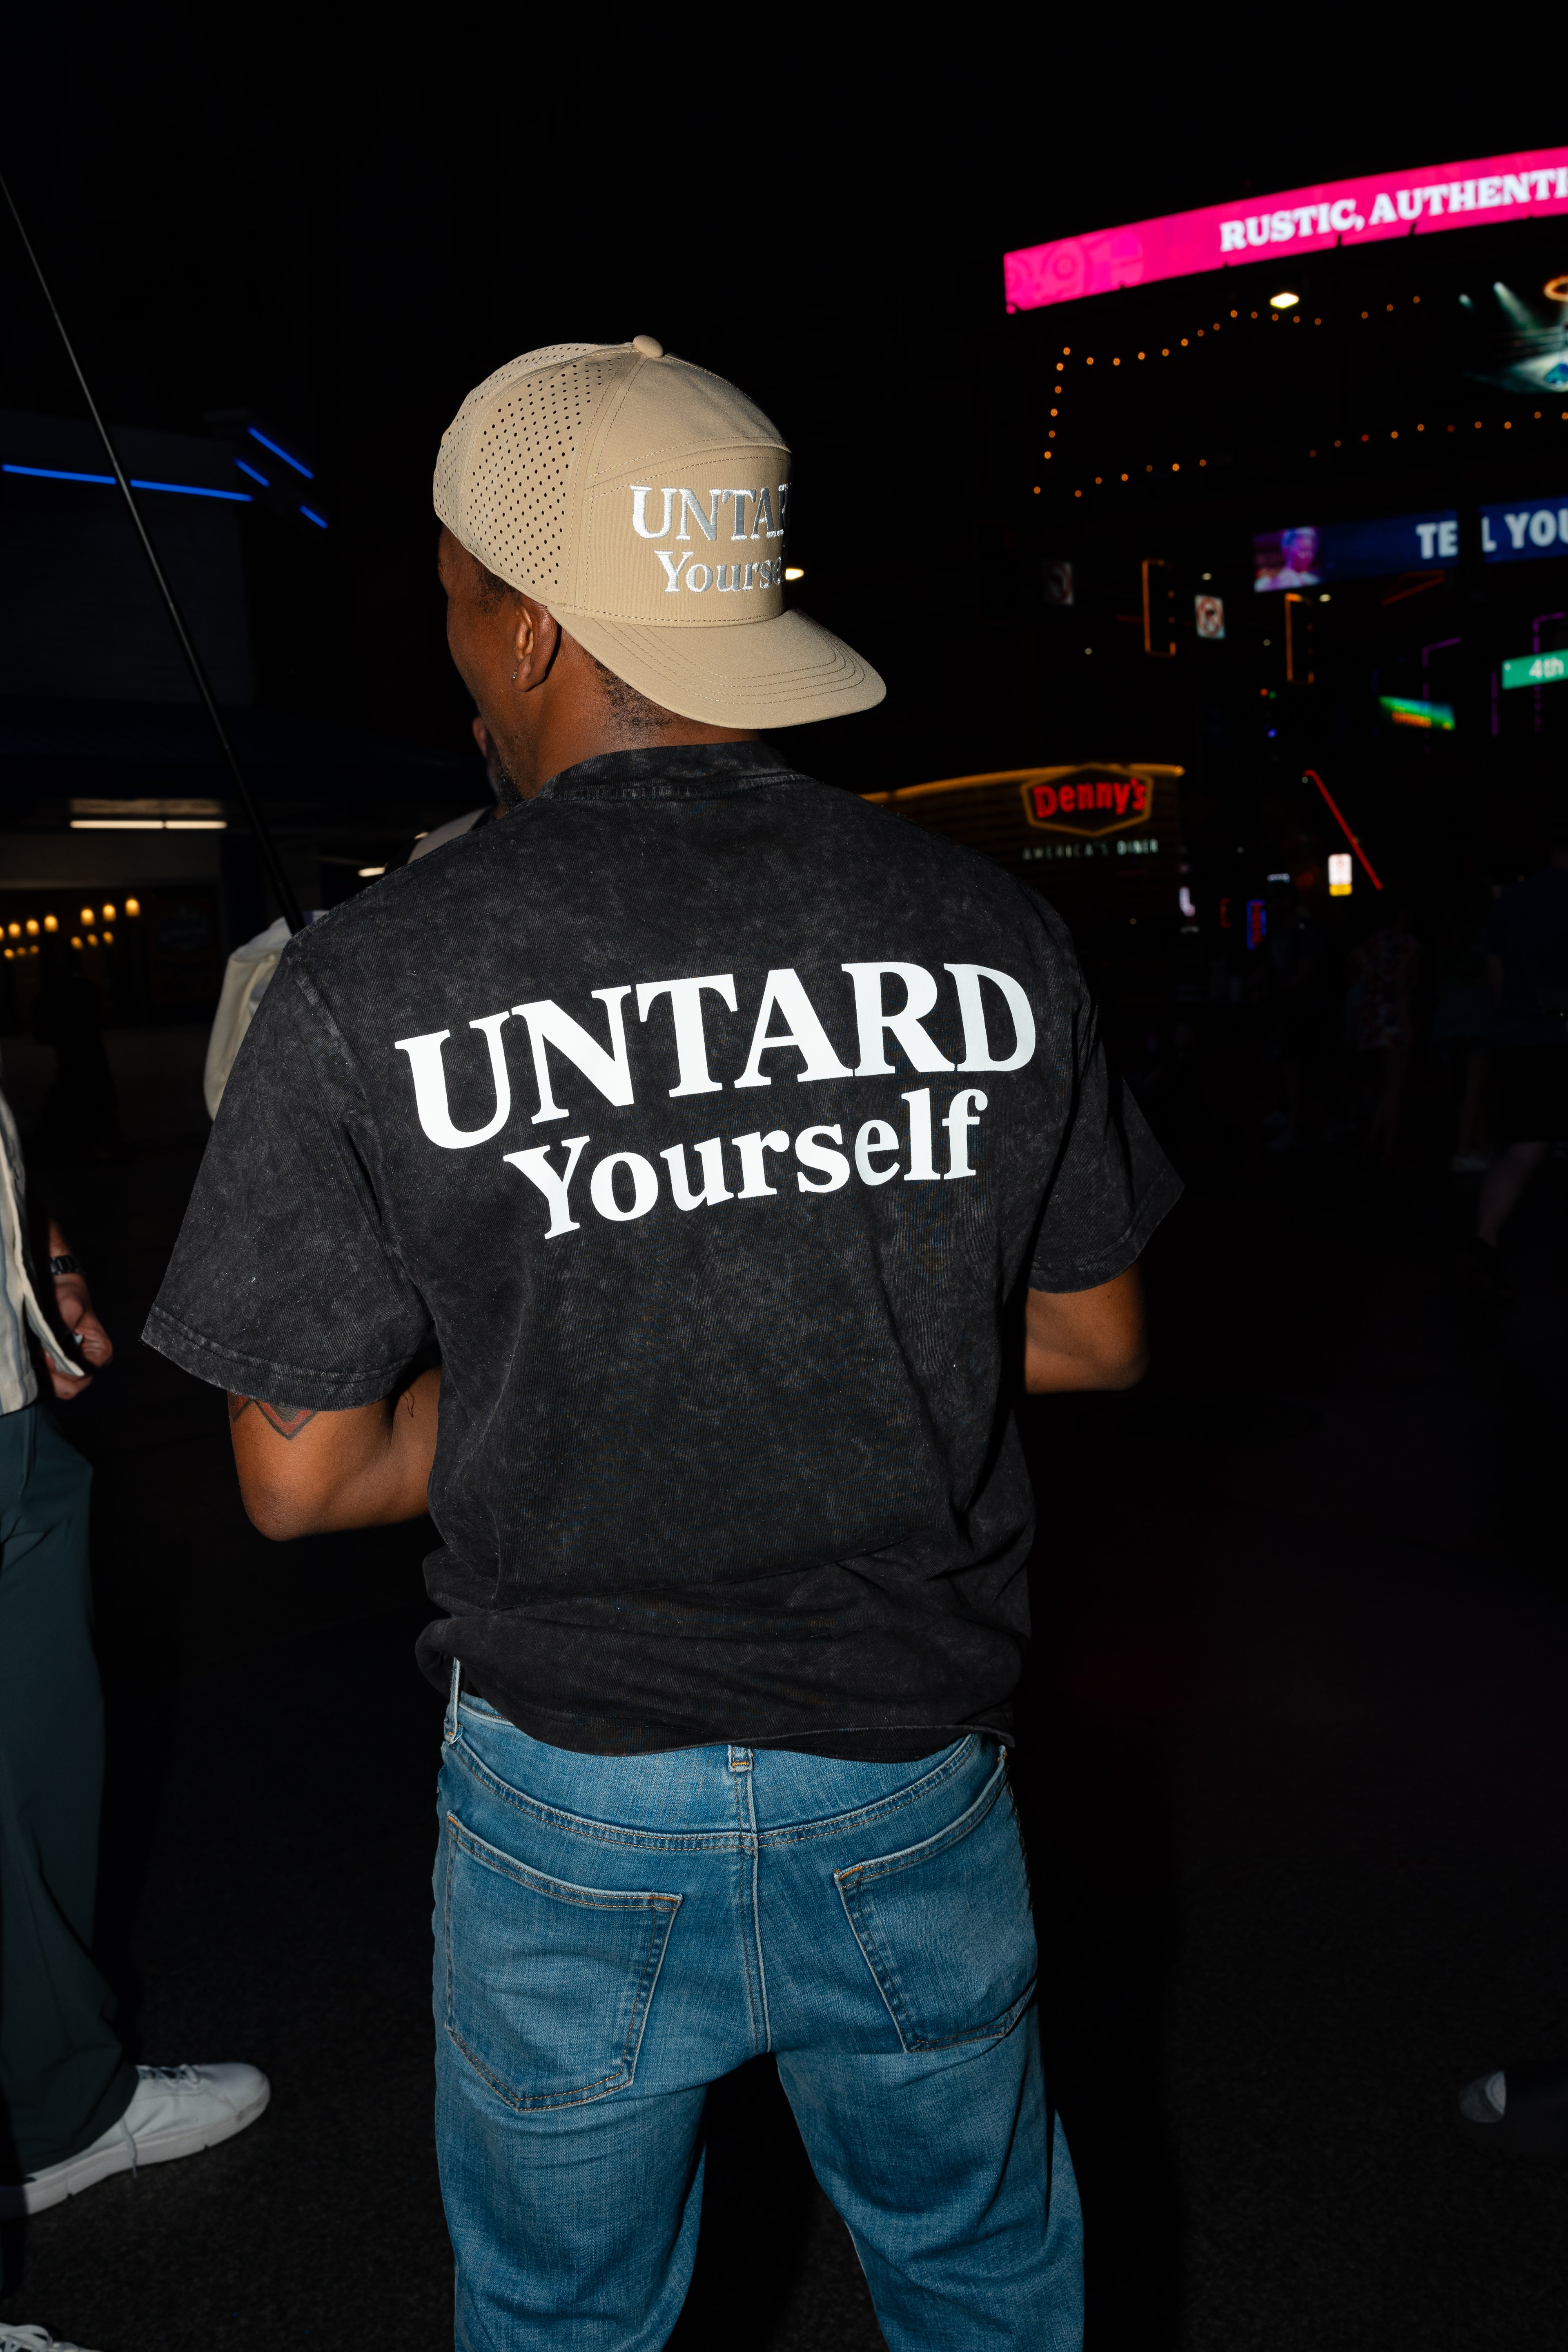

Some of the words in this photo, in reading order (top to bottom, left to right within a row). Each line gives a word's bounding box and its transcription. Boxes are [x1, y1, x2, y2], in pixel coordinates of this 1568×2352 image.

[1220, 198, 1365, 252] RUSTIC,
[1415, 515, 1498, 560] TEL
[1528, 657, 1564, 679] 4th
[1033, 778, 1146, 818] Denny's
[1022, 840, 1109, 861] AMERICA'S
[395, 962, 1036, 1149] UNTARD
[503, 1088, 988, 1240] Yourself
